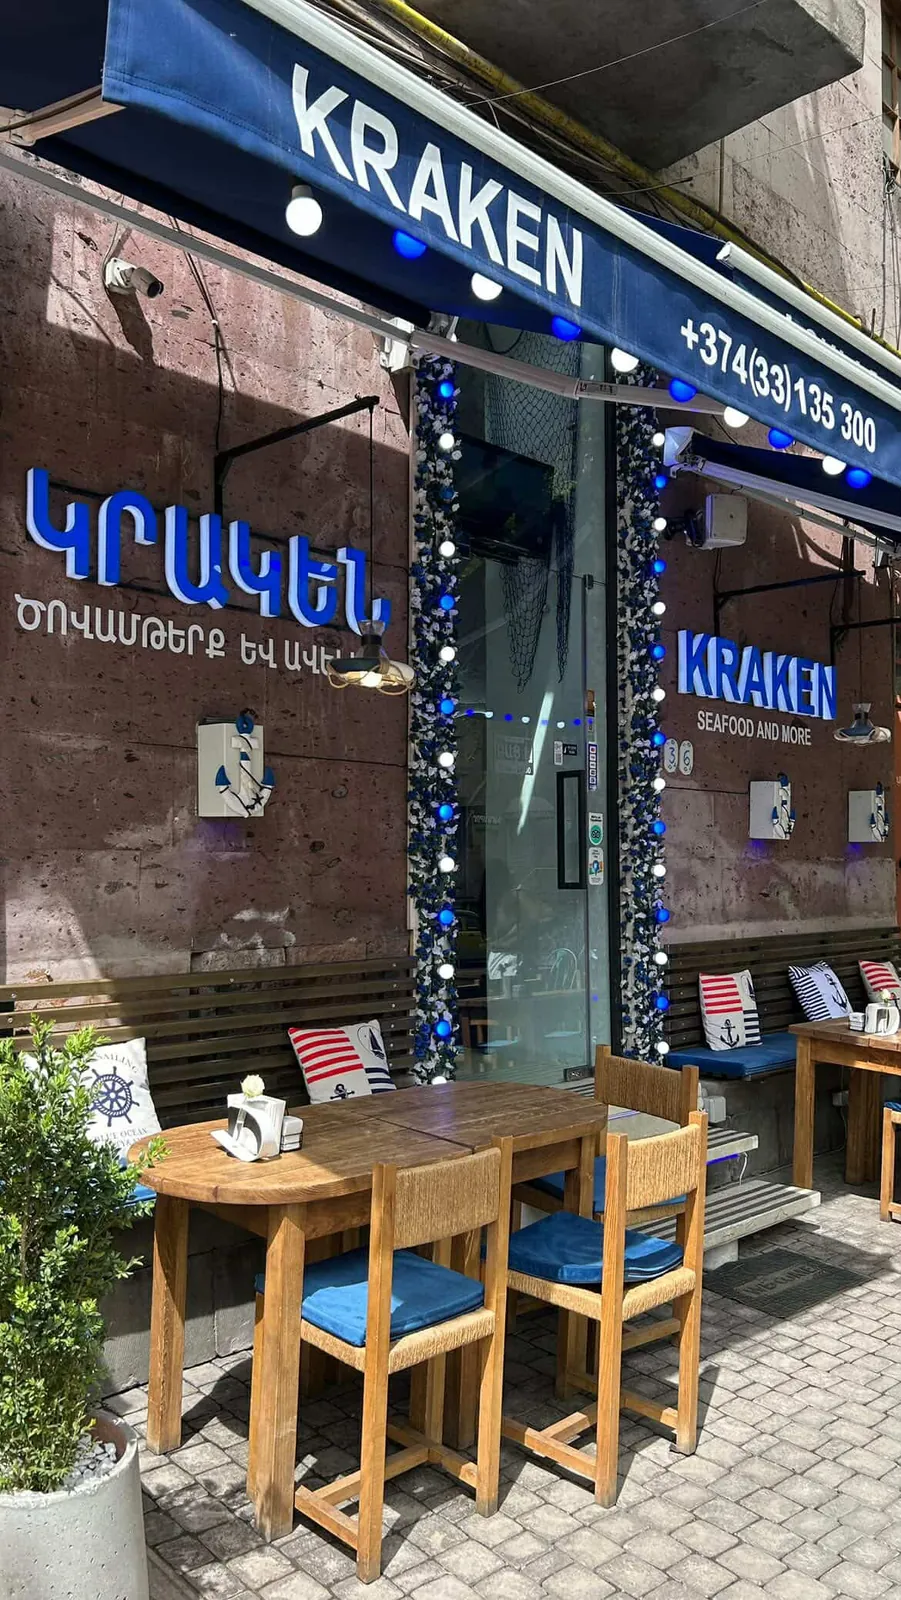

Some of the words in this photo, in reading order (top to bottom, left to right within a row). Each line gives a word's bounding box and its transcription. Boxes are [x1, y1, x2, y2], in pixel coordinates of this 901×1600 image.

[292, 62, 583, 307] KRAKEN
[840, 402, 876, 453] 300
[26, 467, 392, 637] ԿՐԱԿԵՆ
[14, 593, 226, 659] ԾՈՎԱՄԹԵՐՔ
[240, 633, 277, 669] ԵՎ
[677, 629, 837, 721] KRAKEN
[697, 710, 754, 737] SEAFOOD
[756, 720, 779, 741] AND
[781, 724, 812, 746] MORE
